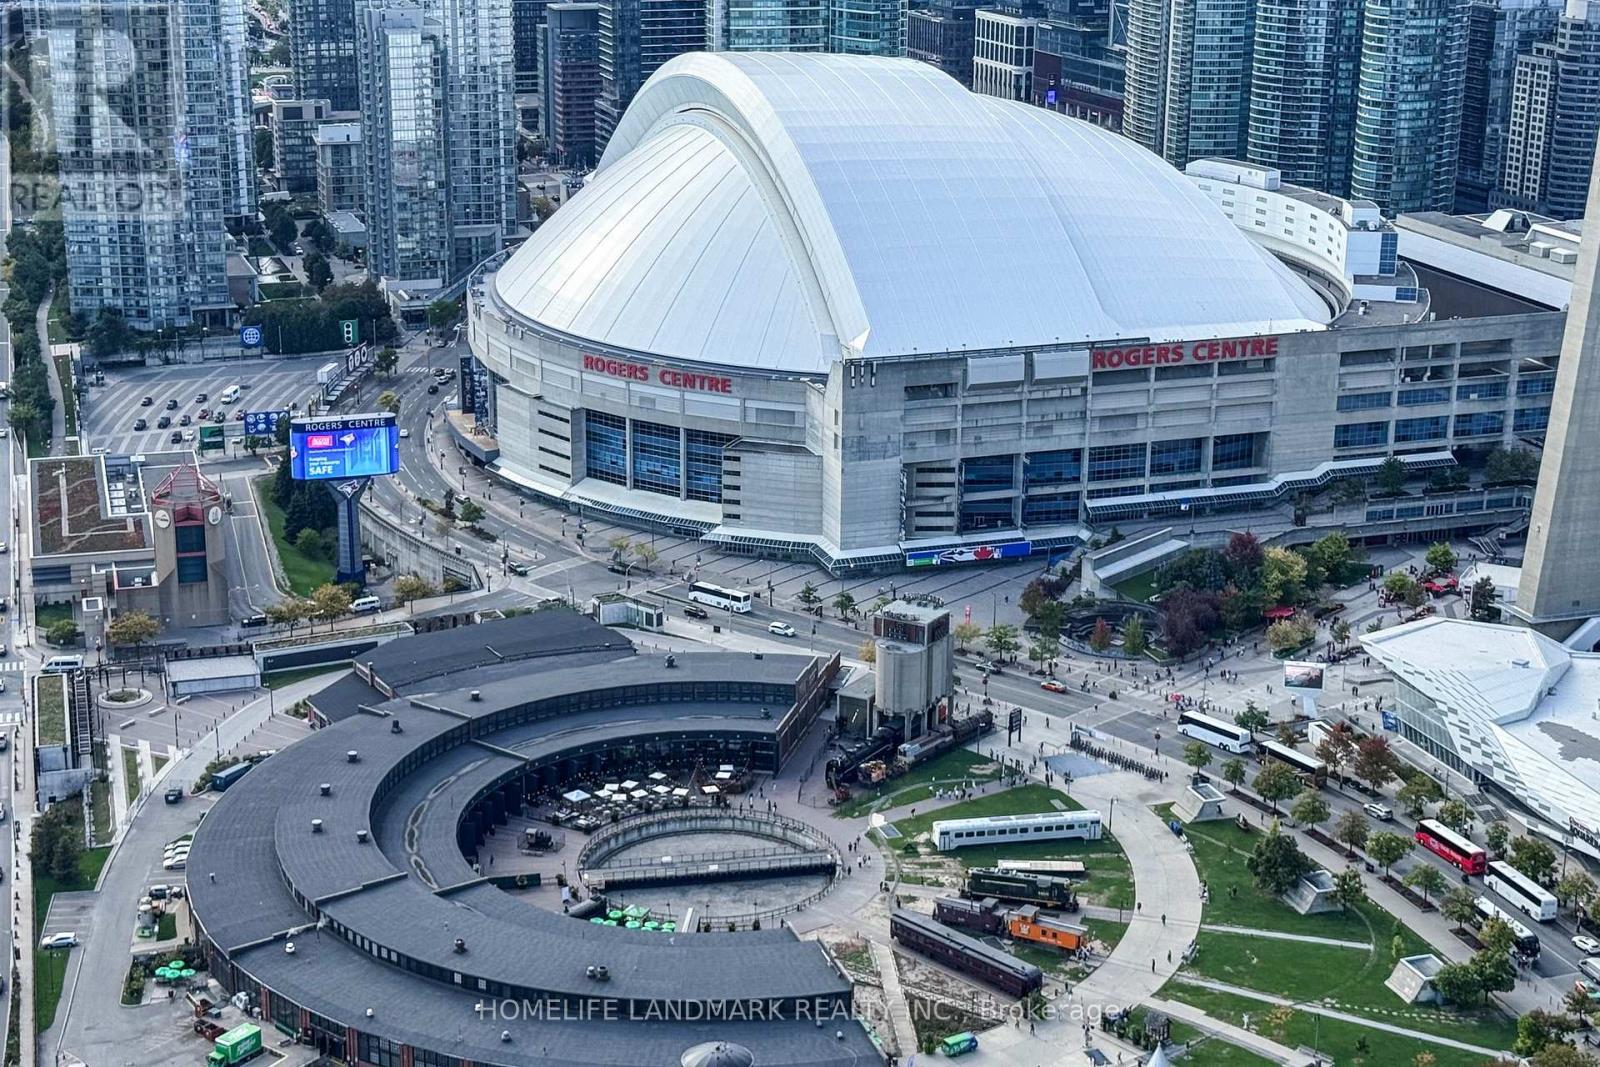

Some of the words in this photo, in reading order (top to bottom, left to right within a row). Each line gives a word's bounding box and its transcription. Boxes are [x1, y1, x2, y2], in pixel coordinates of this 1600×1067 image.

[1092, 344, 1185, 369] ROGERS
[1192, 337, 1279, 361] CENTRE
[583, 354, 649, 382] ROGERS
[659, 369, 732, 394] CENTRE
[305, 421, 343, 431] ROGERS
[348, 418, 386, 428] CENTRE
[309, 466, 333, 475] SAFE
